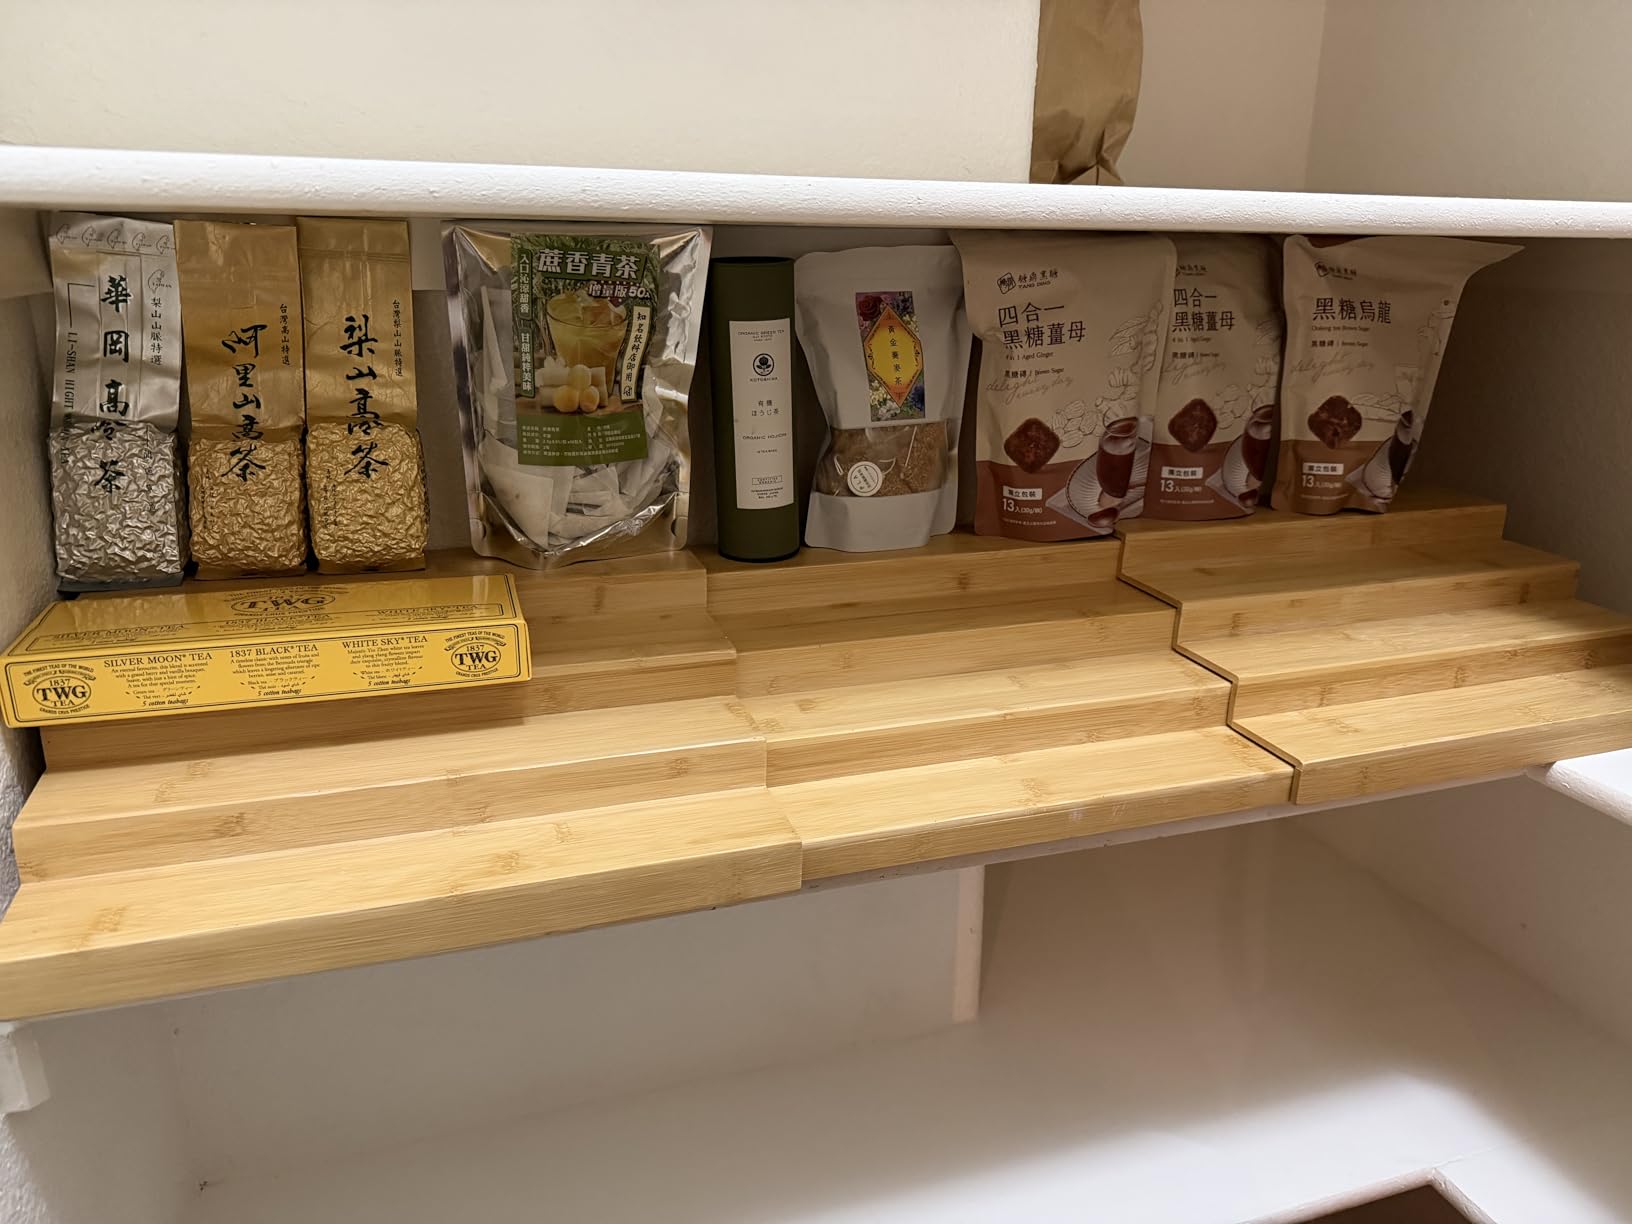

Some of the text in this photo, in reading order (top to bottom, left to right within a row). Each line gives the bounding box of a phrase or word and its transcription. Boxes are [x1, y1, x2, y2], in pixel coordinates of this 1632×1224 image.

[538, 249, 640, 279] 蔗香青茶
[1174, 288, 1217, 307] 四合一
[998, 302, 1064, 328] 四合一
[1313, 297, 1391, 324] 黑糖烏龍
[1172, 311, 1235, 332] 黑糖薑母
[1003, 321, 1086, 350] 黑糖薑母
[65, 332, 78, 374] LI-SHAN
[240, 597, 326, 609] TWG
[342, 639, 378, 648] WHITE
[406, 635, 428, 643] TEA
[230, 649, 252, 657] 1837
[296, 644, 318, 652] TEA
[455, 650, 498, 665] TWG
[104, 658, 144, 668] SILVER
[189, 652, 212, 661] TEA
[36, 685, 88, 701] TWG
[51, 699, 76, 707] TEA
